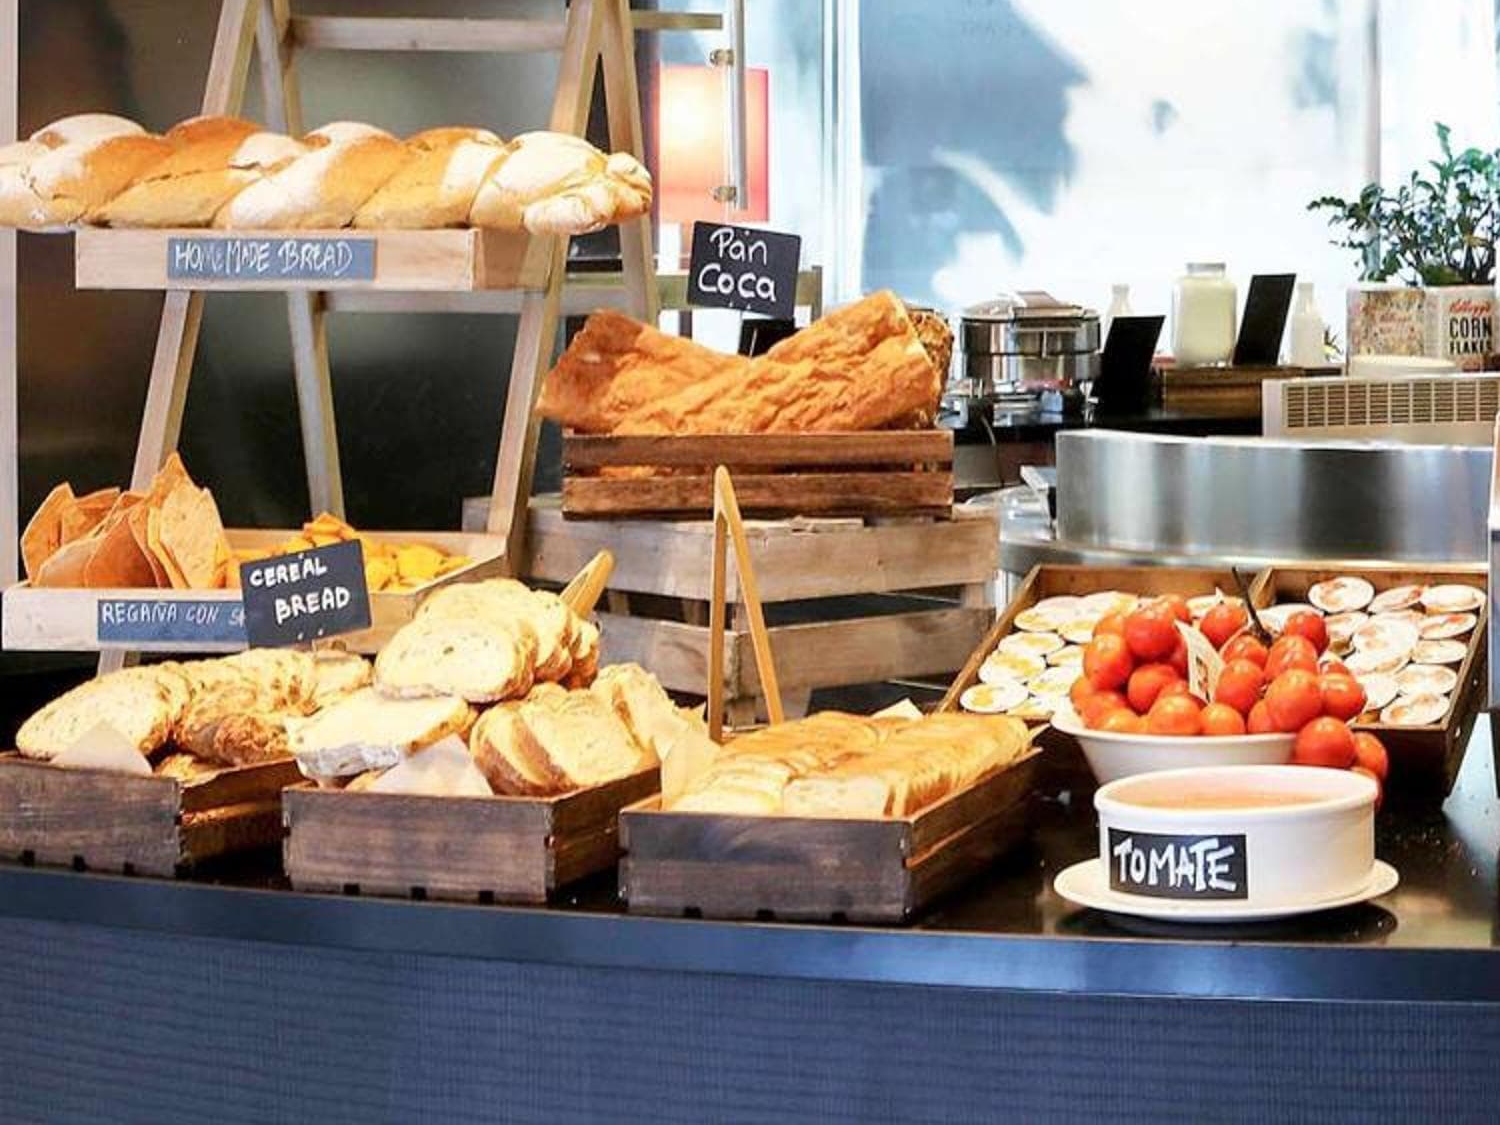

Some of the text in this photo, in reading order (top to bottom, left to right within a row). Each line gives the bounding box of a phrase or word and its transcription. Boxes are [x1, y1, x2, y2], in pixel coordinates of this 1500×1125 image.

[278, 241, 353, 275] BREAD
[710, 227, 767, 265] Pan
[698, 263, 776, 302] Coca
[1449, 316, 1493, 340] CORN
[249, 557, 328, 587] CEREAL
[275, 586, 350, 625] BREAD
[1113, 837, 1238, 892] TOMATE
